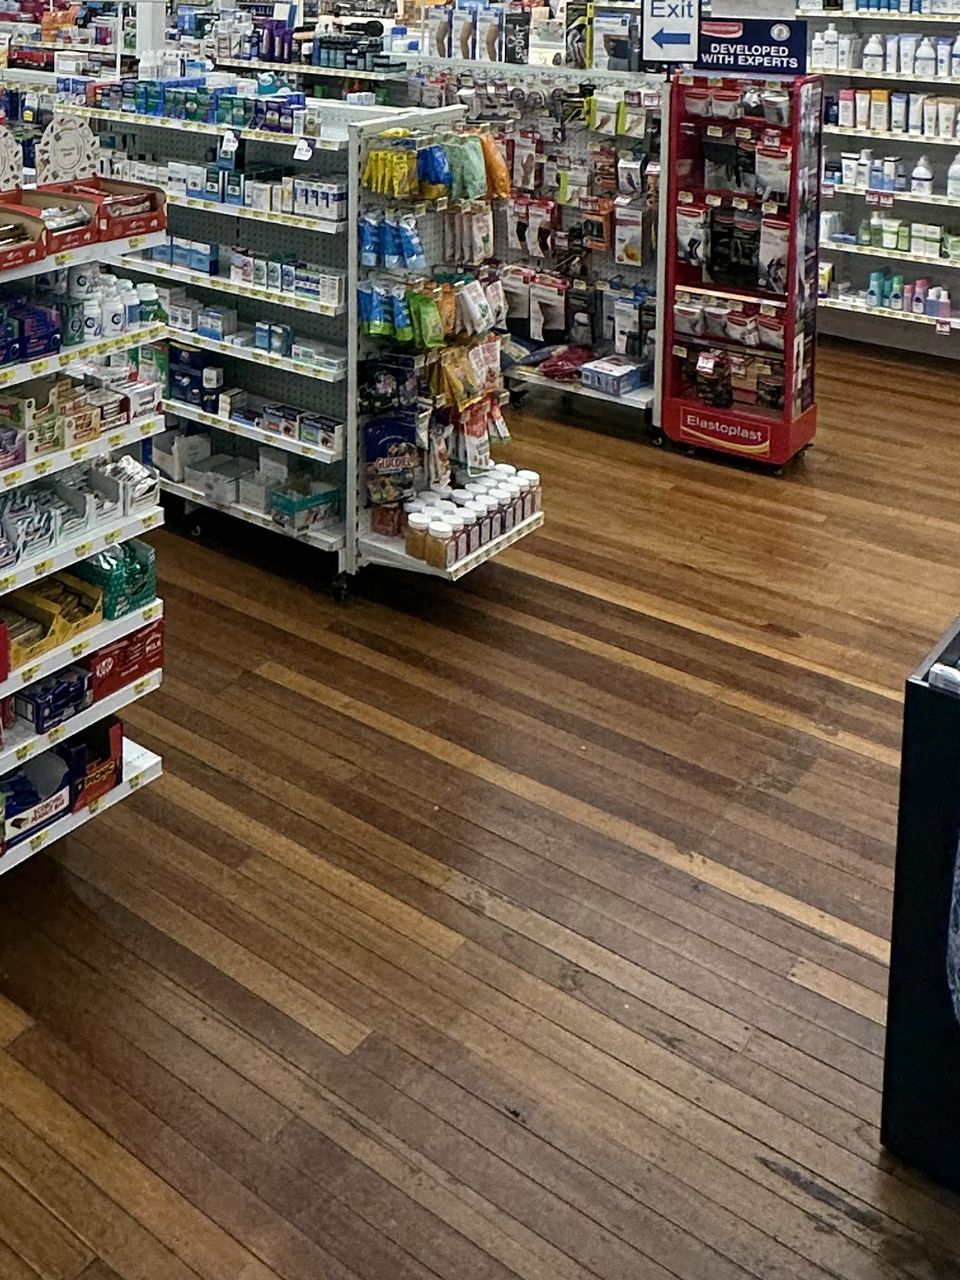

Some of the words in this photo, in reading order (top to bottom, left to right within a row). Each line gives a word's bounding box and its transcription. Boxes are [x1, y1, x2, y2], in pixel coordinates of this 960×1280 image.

[650, 0, 694, 19] Exit
[710, 43, 789, 57] DEVELOPED
[701, 53, 735, 65] WITH
[737, 55, 799, 68] EXPERTS
[686, 414, 763, 441] Elastoplast
